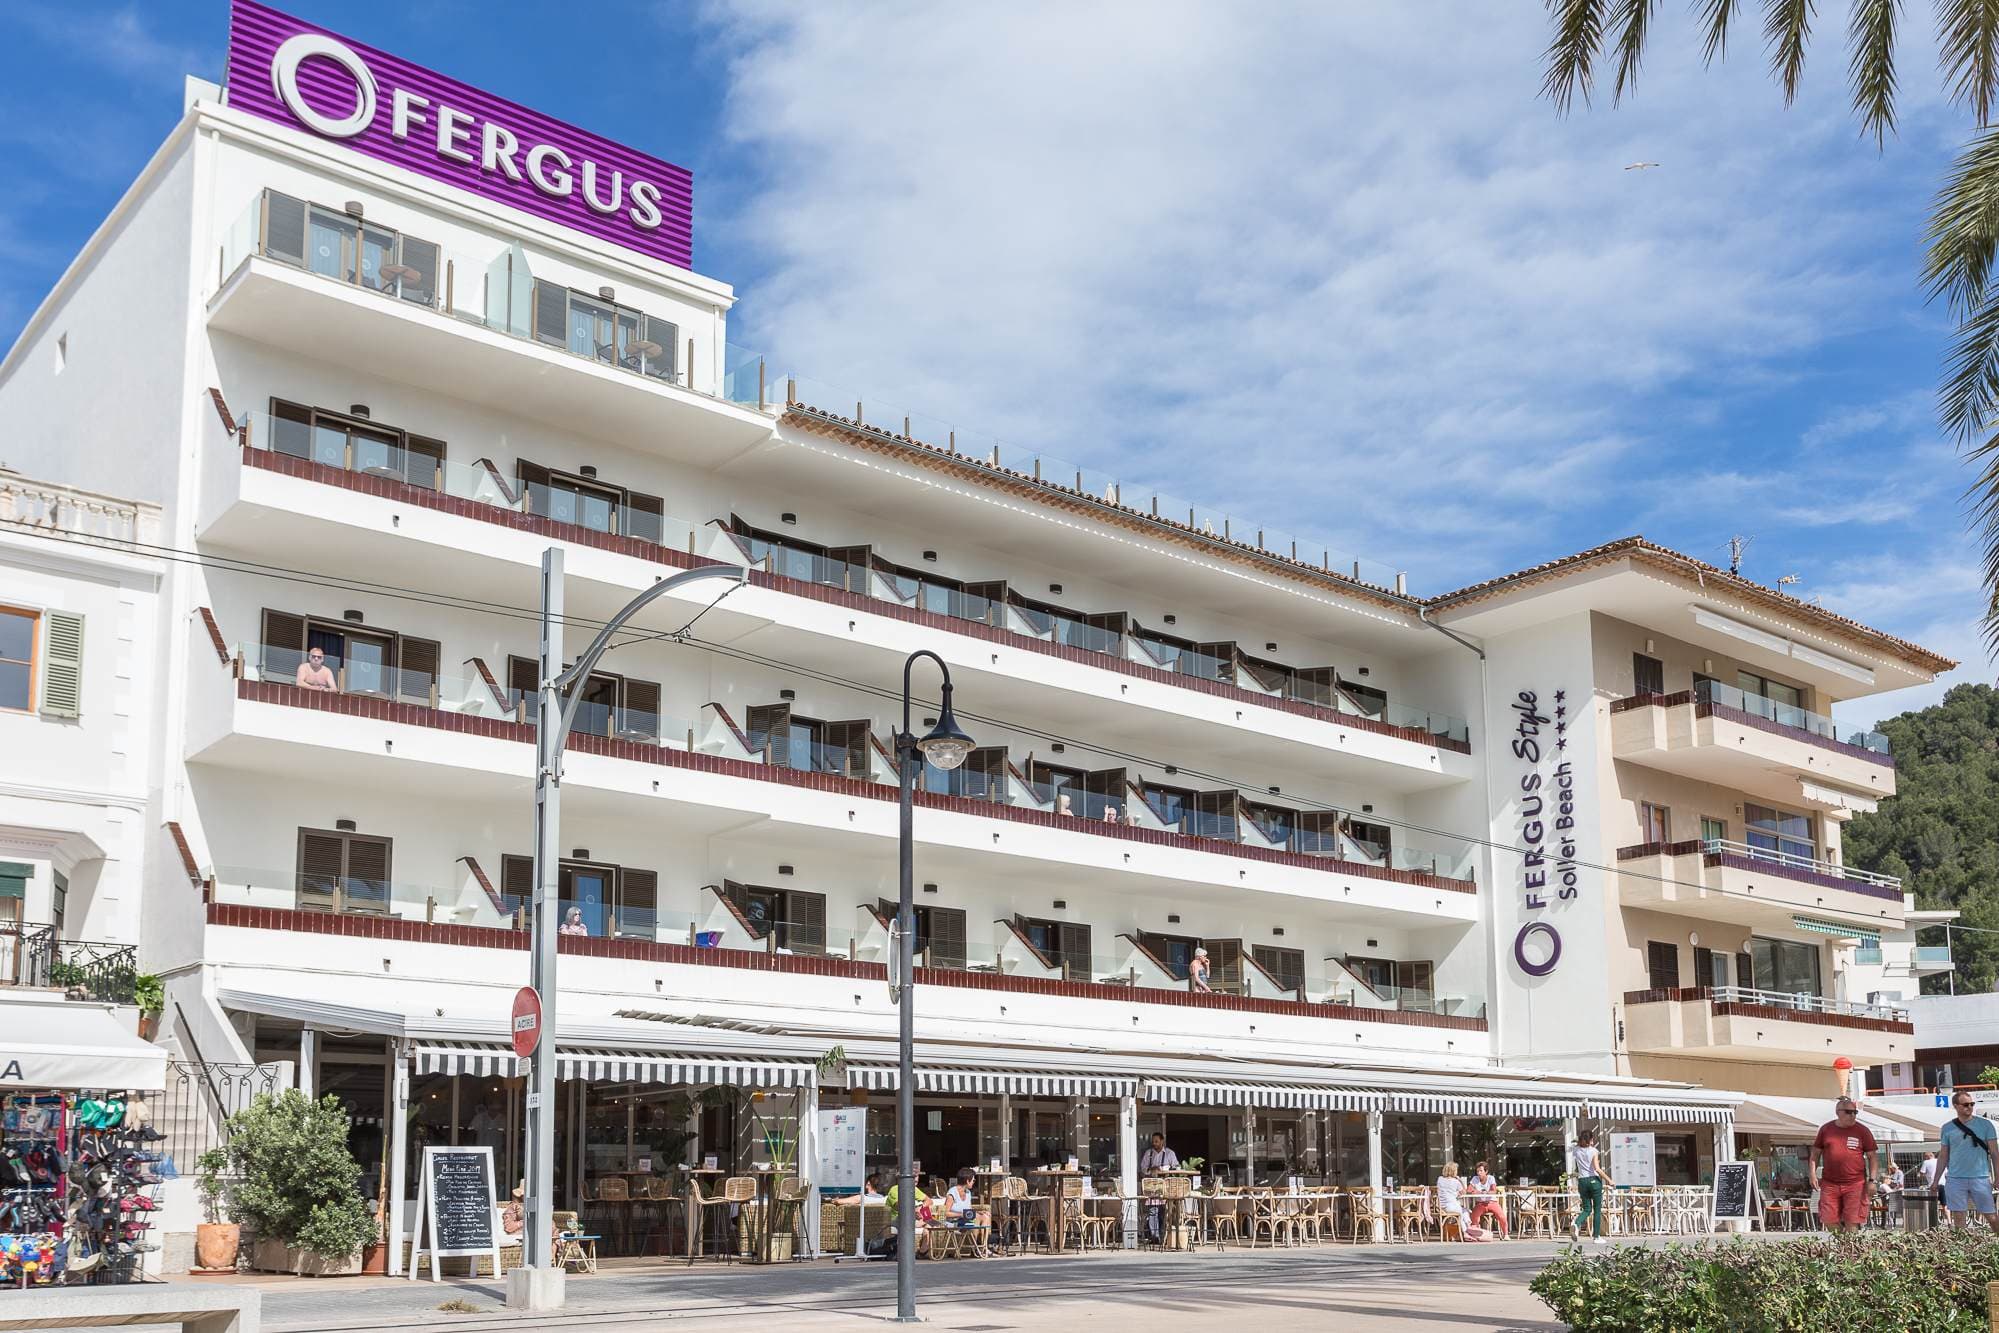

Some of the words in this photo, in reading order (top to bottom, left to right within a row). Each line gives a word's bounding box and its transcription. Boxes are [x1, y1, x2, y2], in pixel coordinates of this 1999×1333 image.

[391, 87, 663, 229] FERGUS
[1511, 690, 1551, 764] Style
[1553, 762, 1574, 830] Beach
[1521, 773, 1547, 910] FERGUS
[1557, 836, 1578, 900] Soller
